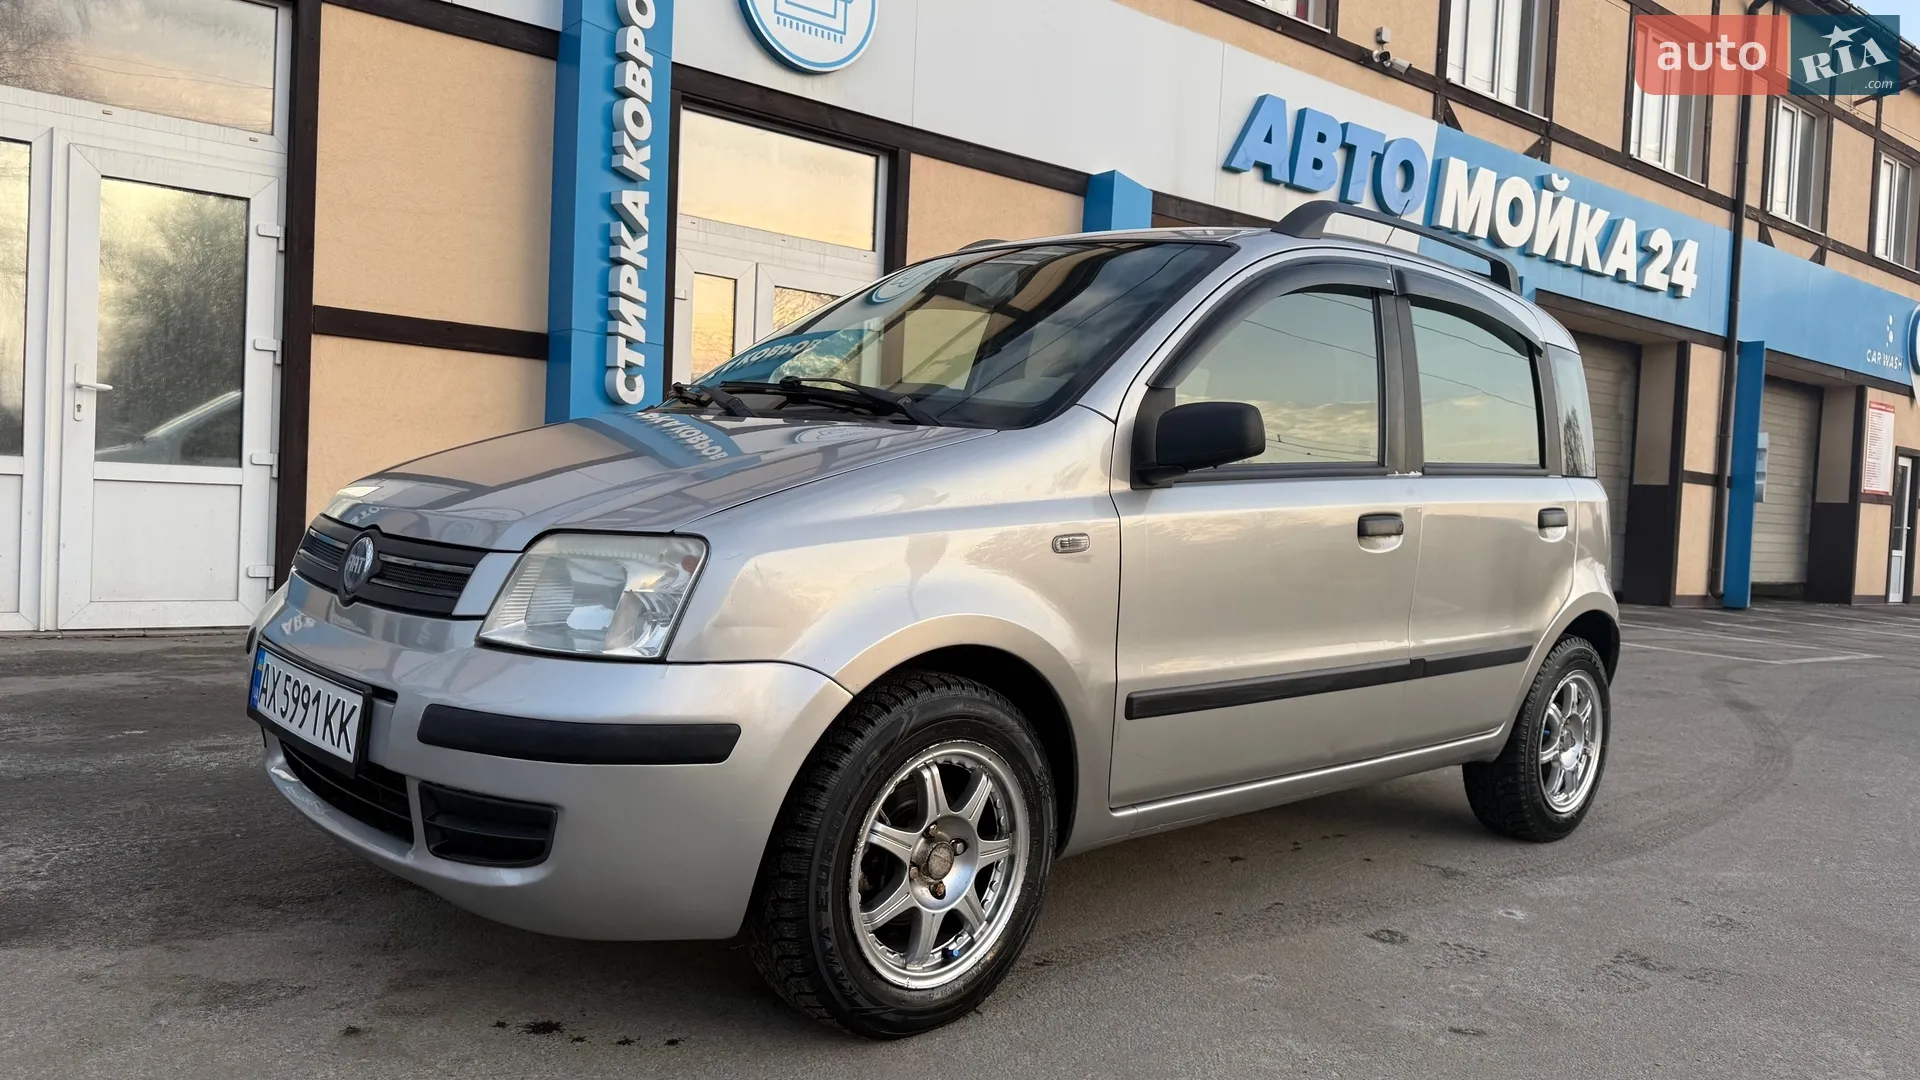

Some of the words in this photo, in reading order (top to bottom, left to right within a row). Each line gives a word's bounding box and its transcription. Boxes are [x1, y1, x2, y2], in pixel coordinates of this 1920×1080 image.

[605, 190, 650, 405] СТИРКА
[1867, 350, 1881, 364] CAR
[1884, 353, 1904, 371] WASH
